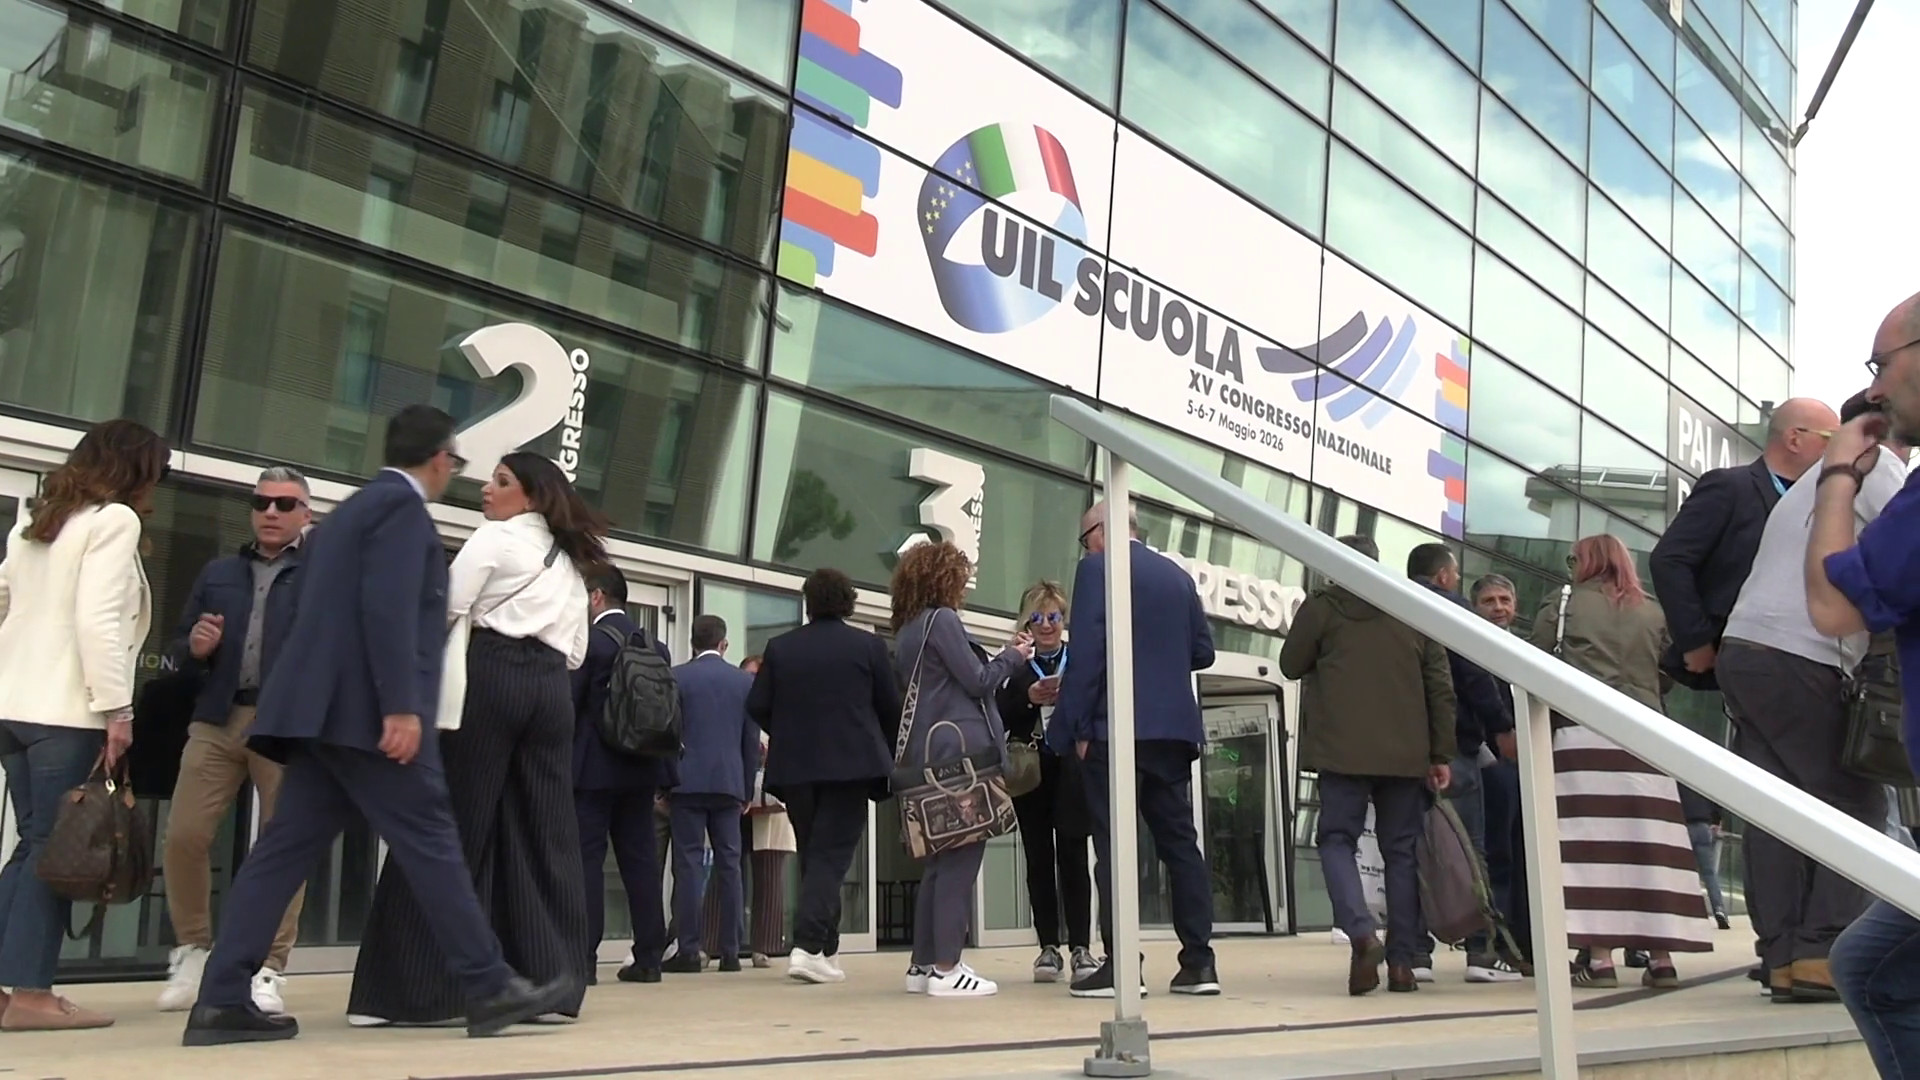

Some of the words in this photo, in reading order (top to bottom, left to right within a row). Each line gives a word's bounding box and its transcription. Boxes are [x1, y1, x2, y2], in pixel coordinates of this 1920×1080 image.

[981, 207, 1063, 303] UIL
[1073, 257, 1244, 384] SCUOLA
[454, 322, 575, 482] 2
[1187, 399, 1216, 422] 5-6-7
[1218, 412, 1257, 441] Maggio
[1259, 428, 1284, 452] 2026
[1189, 368, 1214, 396] XV
[1219, 384, 1312, 439] CONGRESSO
[1316, 426, 1392, 475] NAZIONALE
[897, 447, 982, 565] 3
